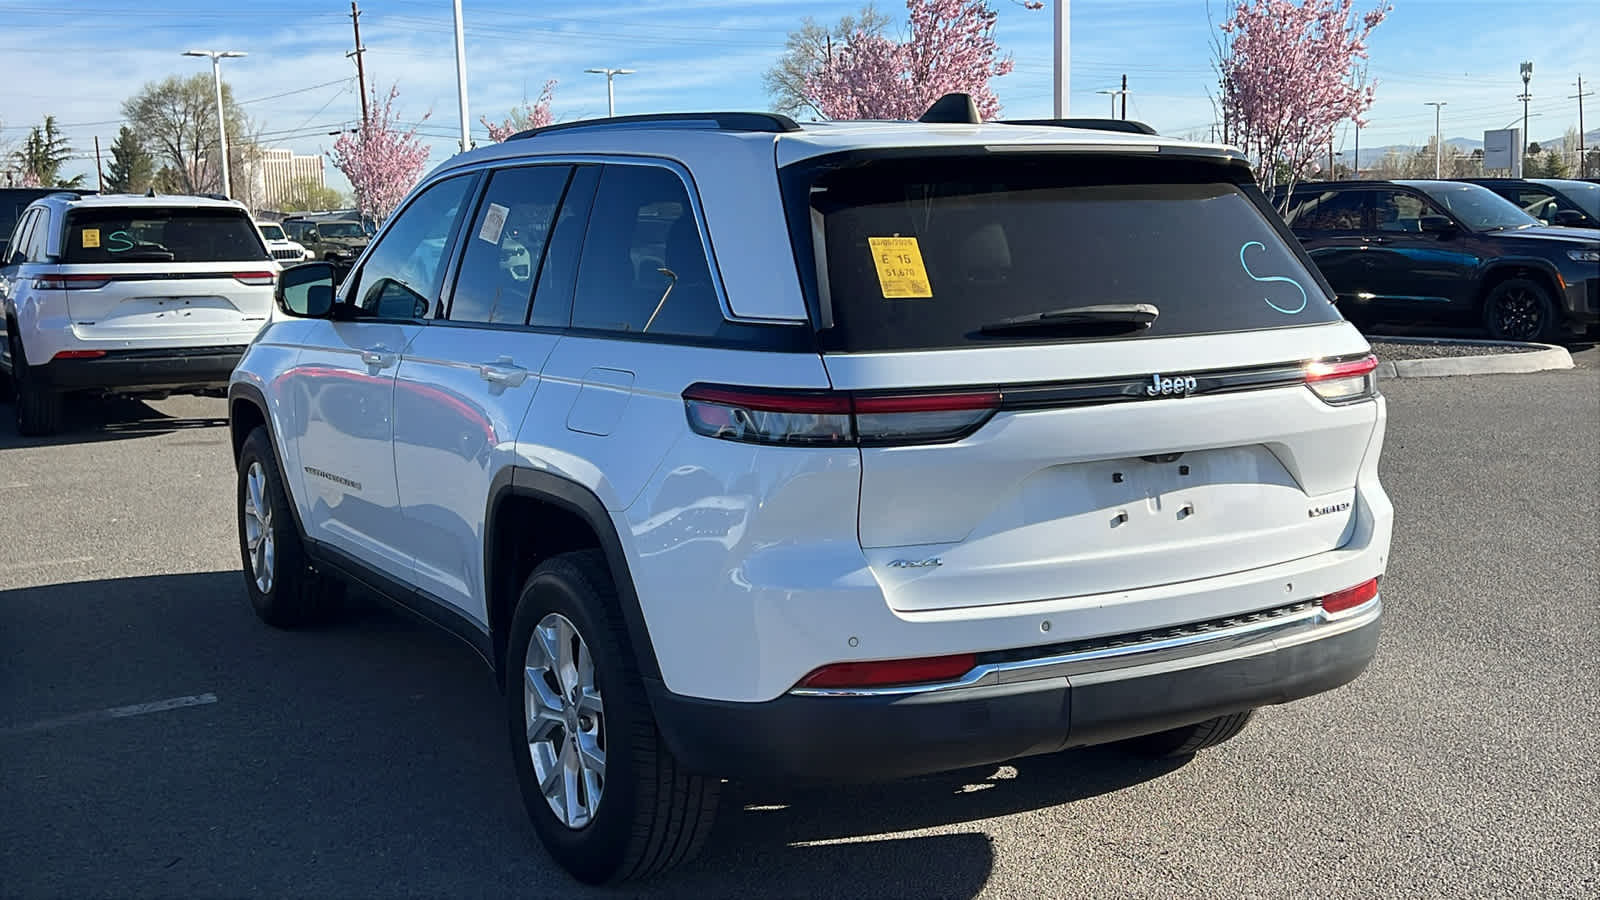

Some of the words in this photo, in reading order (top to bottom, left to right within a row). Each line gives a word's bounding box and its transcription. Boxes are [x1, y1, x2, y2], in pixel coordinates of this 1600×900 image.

[108, 231, 134, 252] S
[882, 254, 889, 264] E
[897, 254, 911, 264] 15
[1240, 241, 1307, 314] S
[1146, 373, 1198, 398] Jeep
